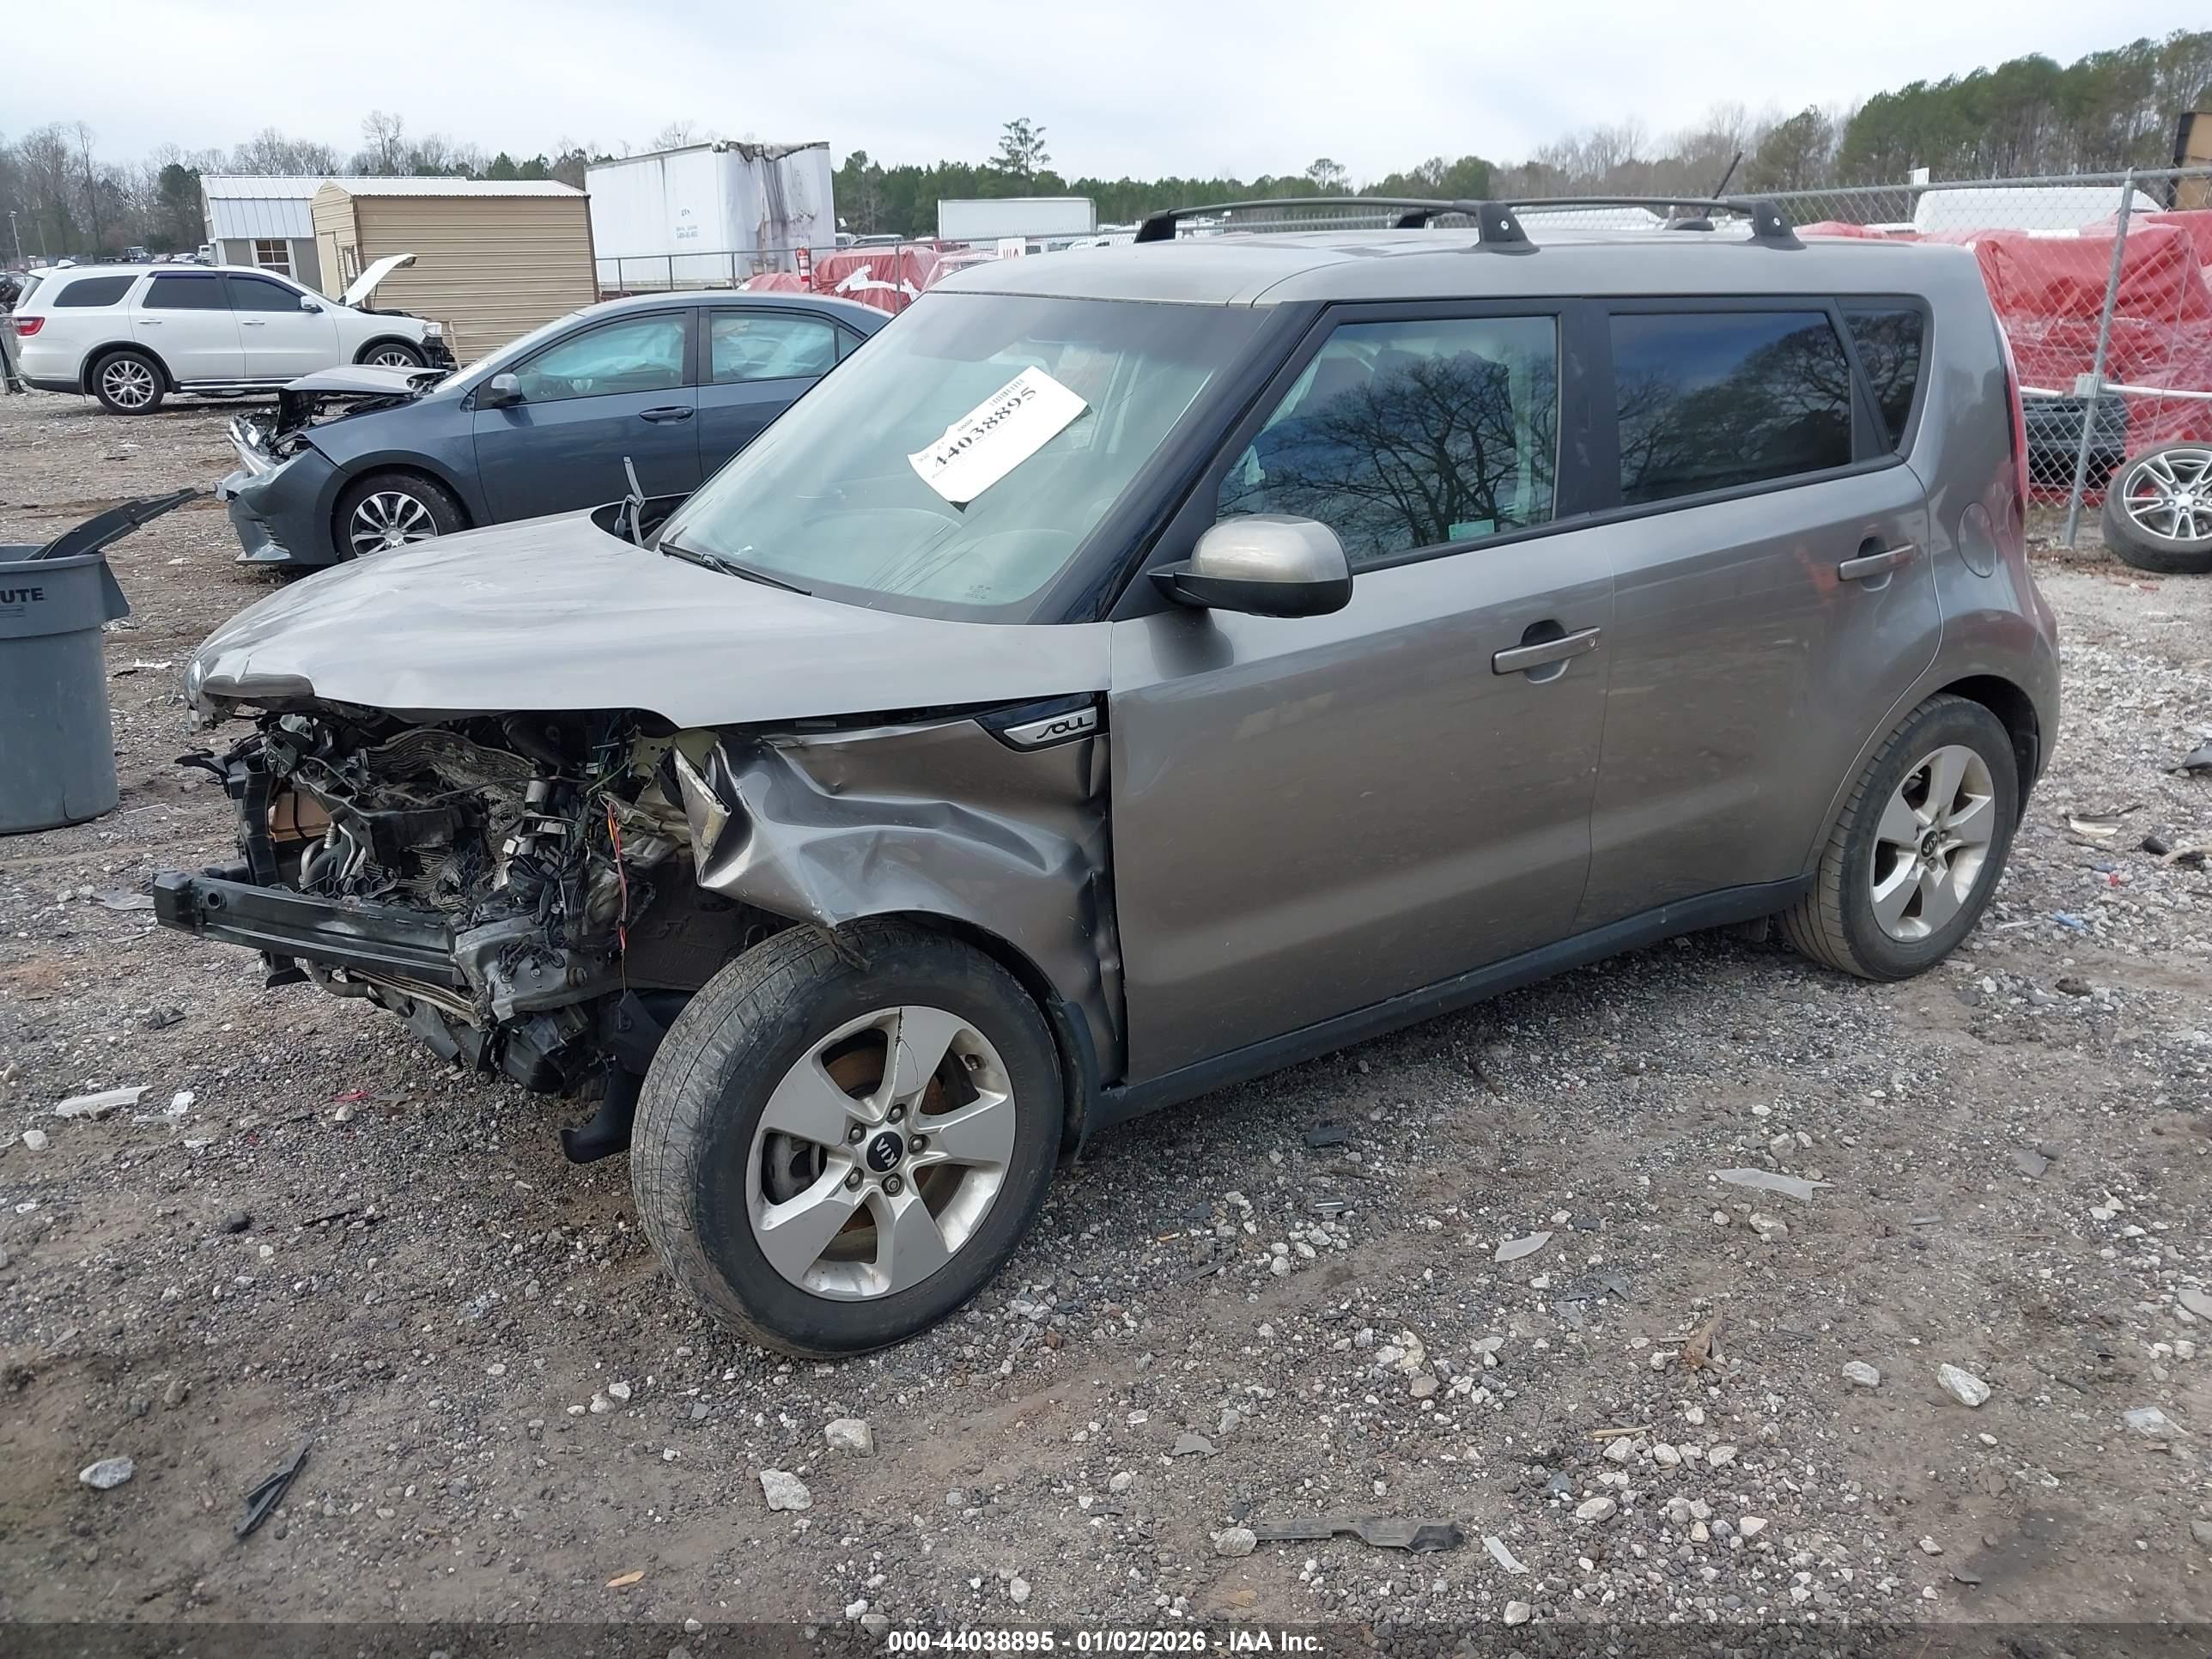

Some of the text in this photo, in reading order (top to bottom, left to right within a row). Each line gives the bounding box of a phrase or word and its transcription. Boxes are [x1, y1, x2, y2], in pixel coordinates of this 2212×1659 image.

[935, 386, 1036, 468] 44038895
[0, 587, 44, 604] UTE
[1036, 717, 1094, 739] SOUL
[876, 1137, 898, 1168] KIA
